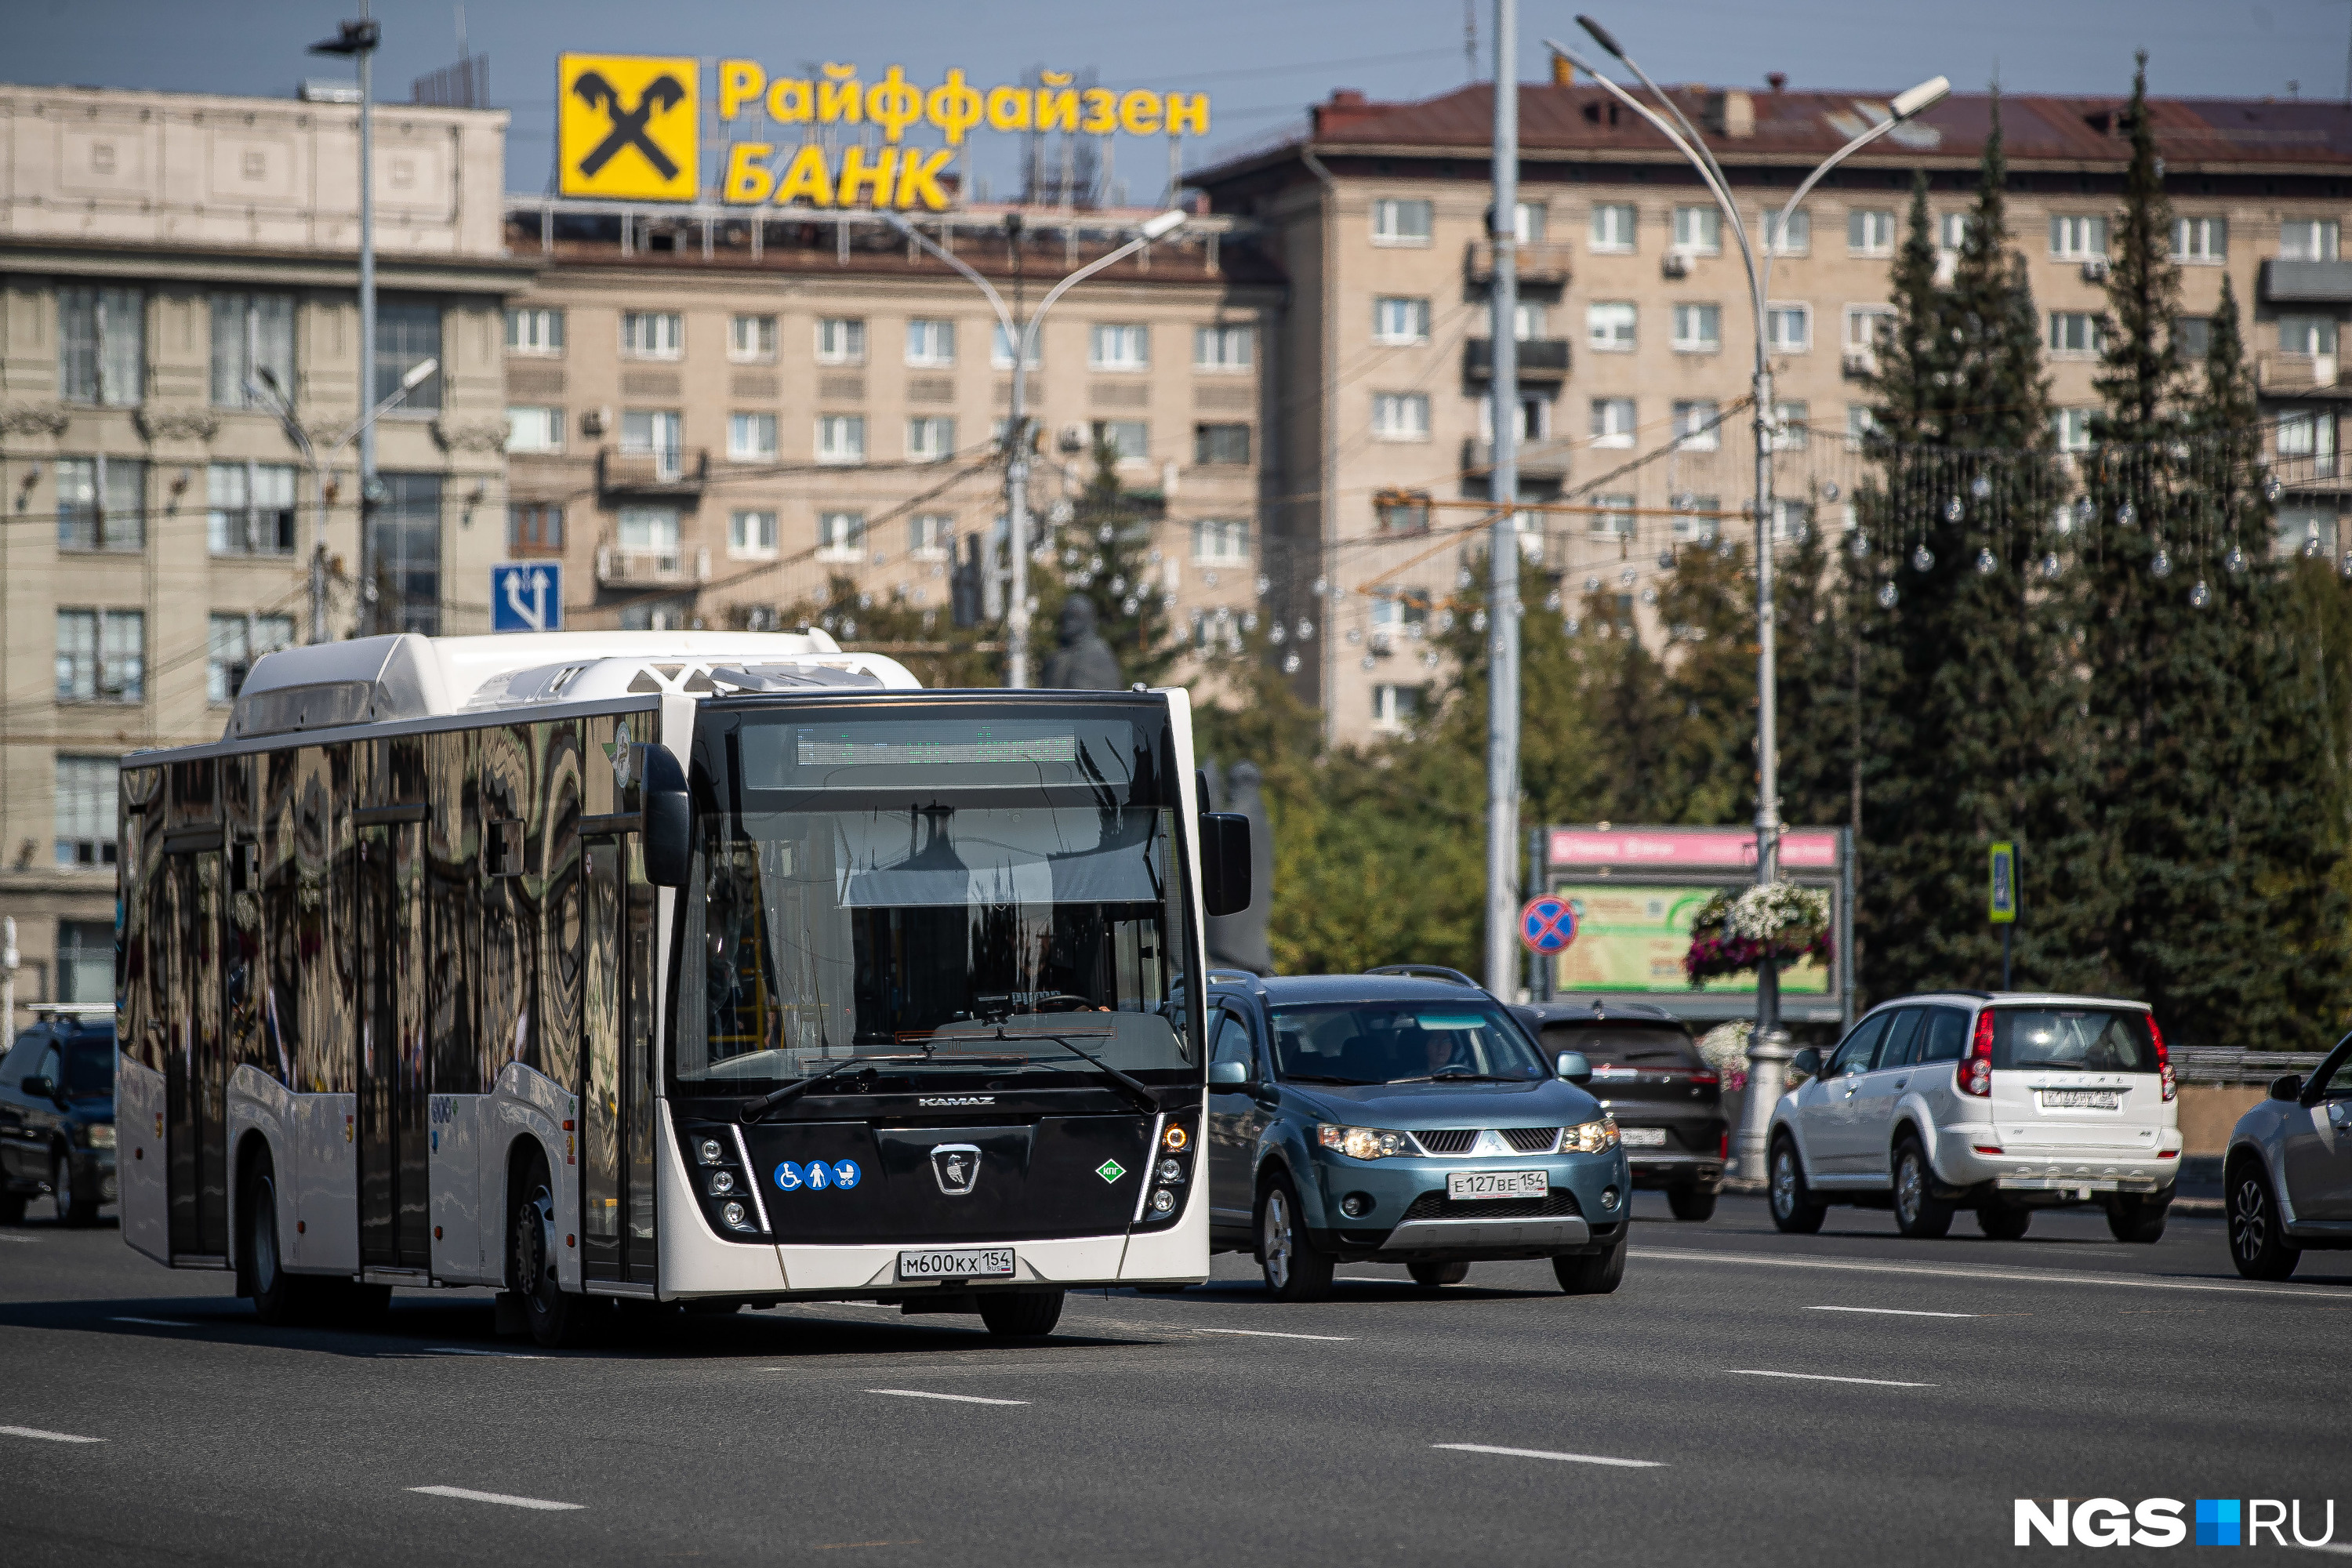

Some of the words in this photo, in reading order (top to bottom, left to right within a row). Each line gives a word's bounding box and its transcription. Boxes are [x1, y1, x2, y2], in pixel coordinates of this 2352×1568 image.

[718, 58, 1210, 146] Райффайзен
[723, 140, 956, 211] БАНК
[919, 1097, 996, 1106] KAMAZ
[1103, 1167, 1120, 1175] КПГ
[1454, 1176, 1518, 1192] Е127ВЕ
[1520, 1173, 1546, 1186] 154
[906, 1254, 978, 1273] М600КХ
[982, 1252, 1009, 1266] 154
